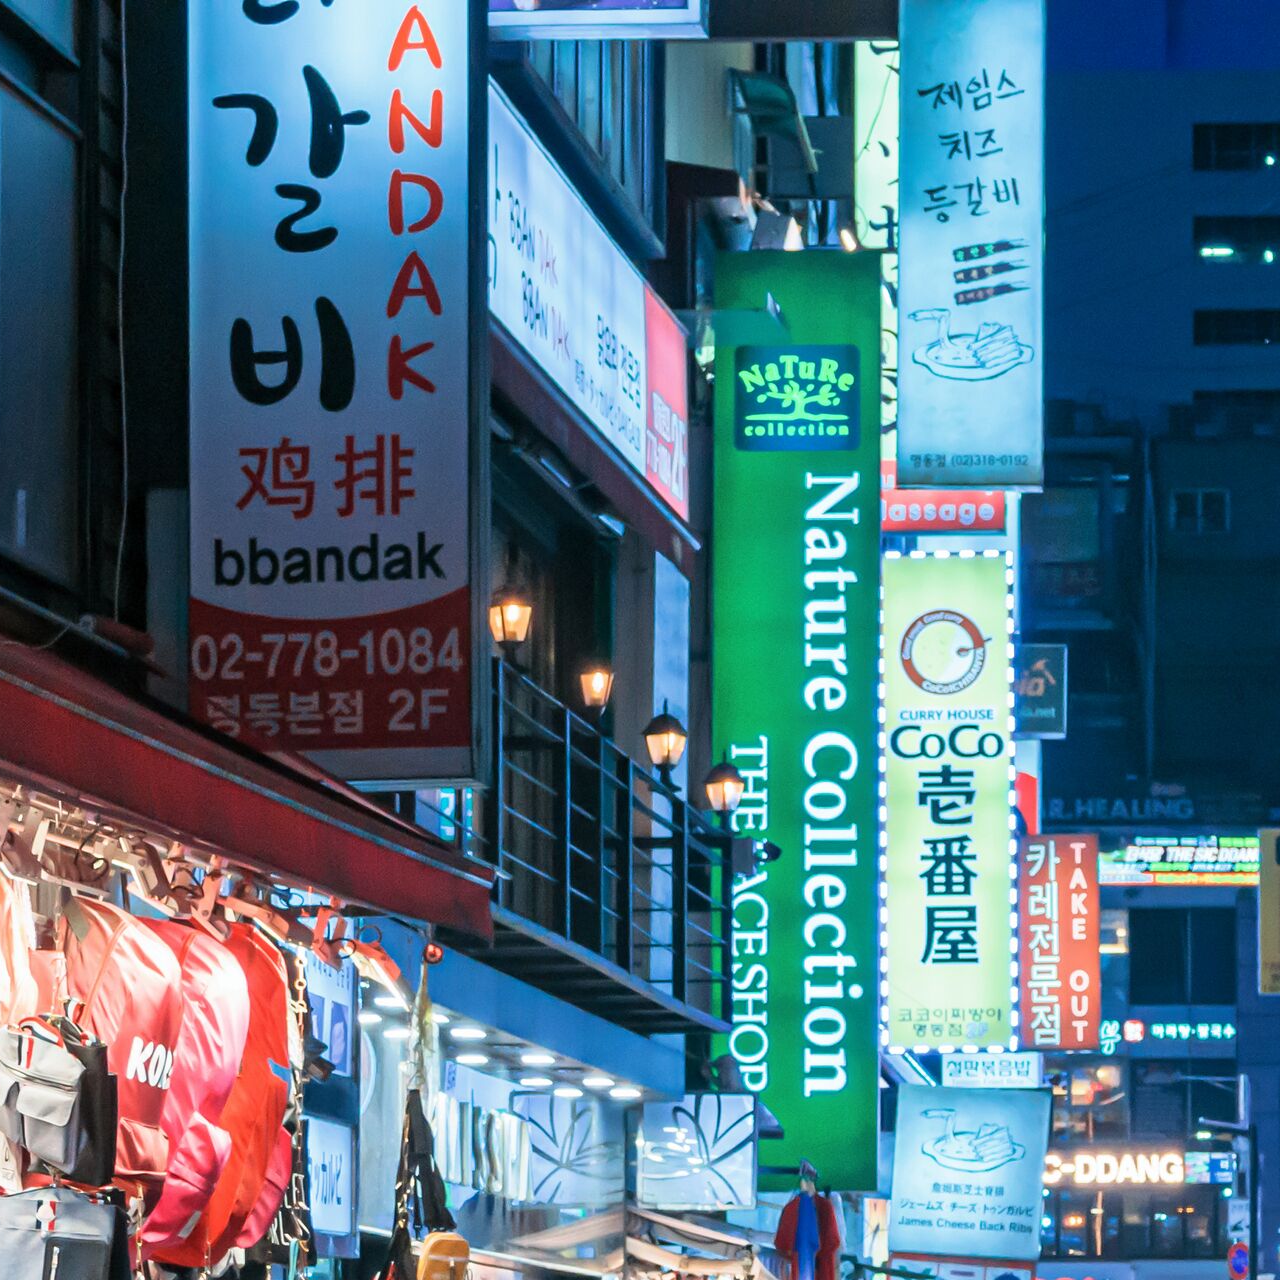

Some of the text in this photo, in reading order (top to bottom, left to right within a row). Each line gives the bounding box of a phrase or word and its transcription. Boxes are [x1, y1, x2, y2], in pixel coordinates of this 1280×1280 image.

[918, 68, 1025, 112] 제임스
[938, 128, 1005, 162] 치즈
[212, 0, 370, 412] 갈비
[922, 178, 1022, 224] 등갈비
[744, 421, 850, 438] collection
[236, 435, 416, 520] 鸡排
[882, 500, 995, 526] assage
[214, 533, 446, 588] bbandak
[191, 627, 464, 681] 02-778-1084
[388, 688, 449, 732] 2F
[900, 709, 994, 721] CURRY HOUSE
[890, 725, 1004, 760] CoCo
[803, 472, 863, 1098] Nature Collection
[918, 766, 980, 965] 壱番屋
[1026, 840, 1061, 1047] 카레전문점
[1069, 842, 1090, 1043] TAKE OUT
[898, 1216, 933, 1228] James
[936, 1218, 976, 1230] Cheese
[979, 1220, 1005, 1231] Back
